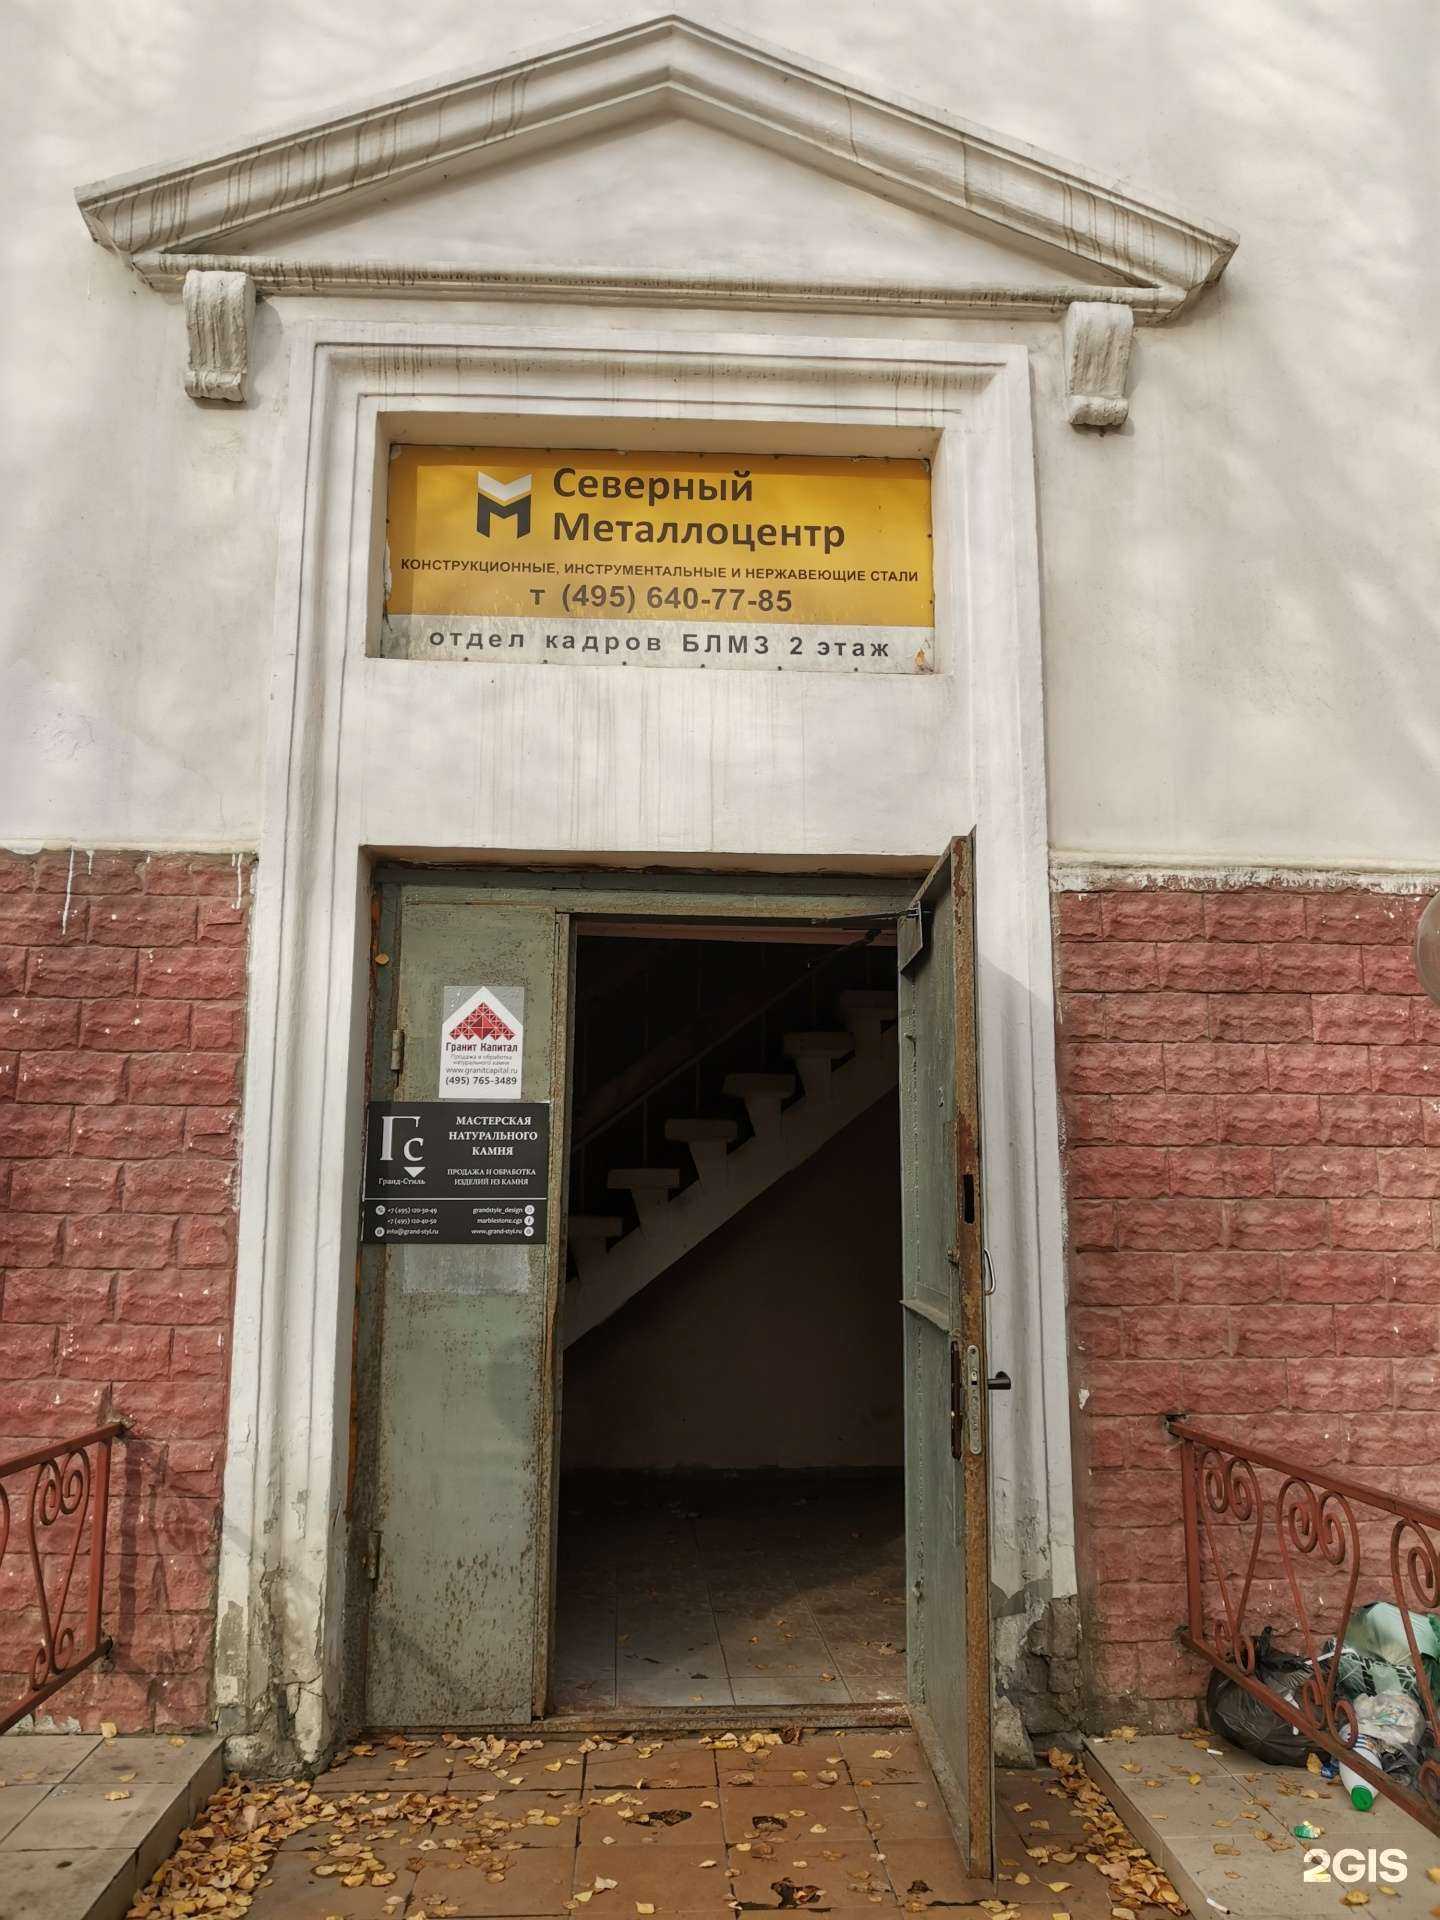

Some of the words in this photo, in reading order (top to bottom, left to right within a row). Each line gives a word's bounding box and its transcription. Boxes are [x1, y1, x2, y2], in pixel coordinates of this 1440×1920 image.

[553, 467, 753, 506] Северный
[553, 511, 845, 554] Металлоцентр
[401, 558, 560, 576] КОНСТРУКЦИОННЫЕ,
[564, 563, 727, 579] ИНСТРУМЕНТАЛЬНЫЕ
[731, 568, 741, 578] И
[745, 568, 866, 583] НЕРЖАВЕЮЩИЕ
[870, 571, 919, 582] СТАЛИ
[562, 584, 635, 613] (495)
[647, 586, 792, 612] 640-77-85
[430, 631, 524, 650] отдел
[546, 634, 662, 654] кадров
[683, 633, 769, 655] БЛМЗ
[790, 636, 803, 655] 2
[817, 640, 889, 657] этаж
[446, 1042, 477, 1052] Гранит
[481, 1043, 518, 1052] Капитал
[446, 1067, 518, 1075] www.granitcapital.ru
[446, 1076, 470, 1086] (495)
[473, 1076, 517, 1085] 765-3489
[456, 1116, 532, 1126] МАСТЕРСКАЯ
[448, 1131, 538, 1141] НАТУРАЛЬНОГО
[472, 1146, 514, 1156] КАМНЯ
[447, 1168, 485, 1176] ПРОДАЖА
[378, 1178, 427, 1187] Гранд-Стиль
[454, 1178, 489, 1186] ИЗДЕЛИЙ
